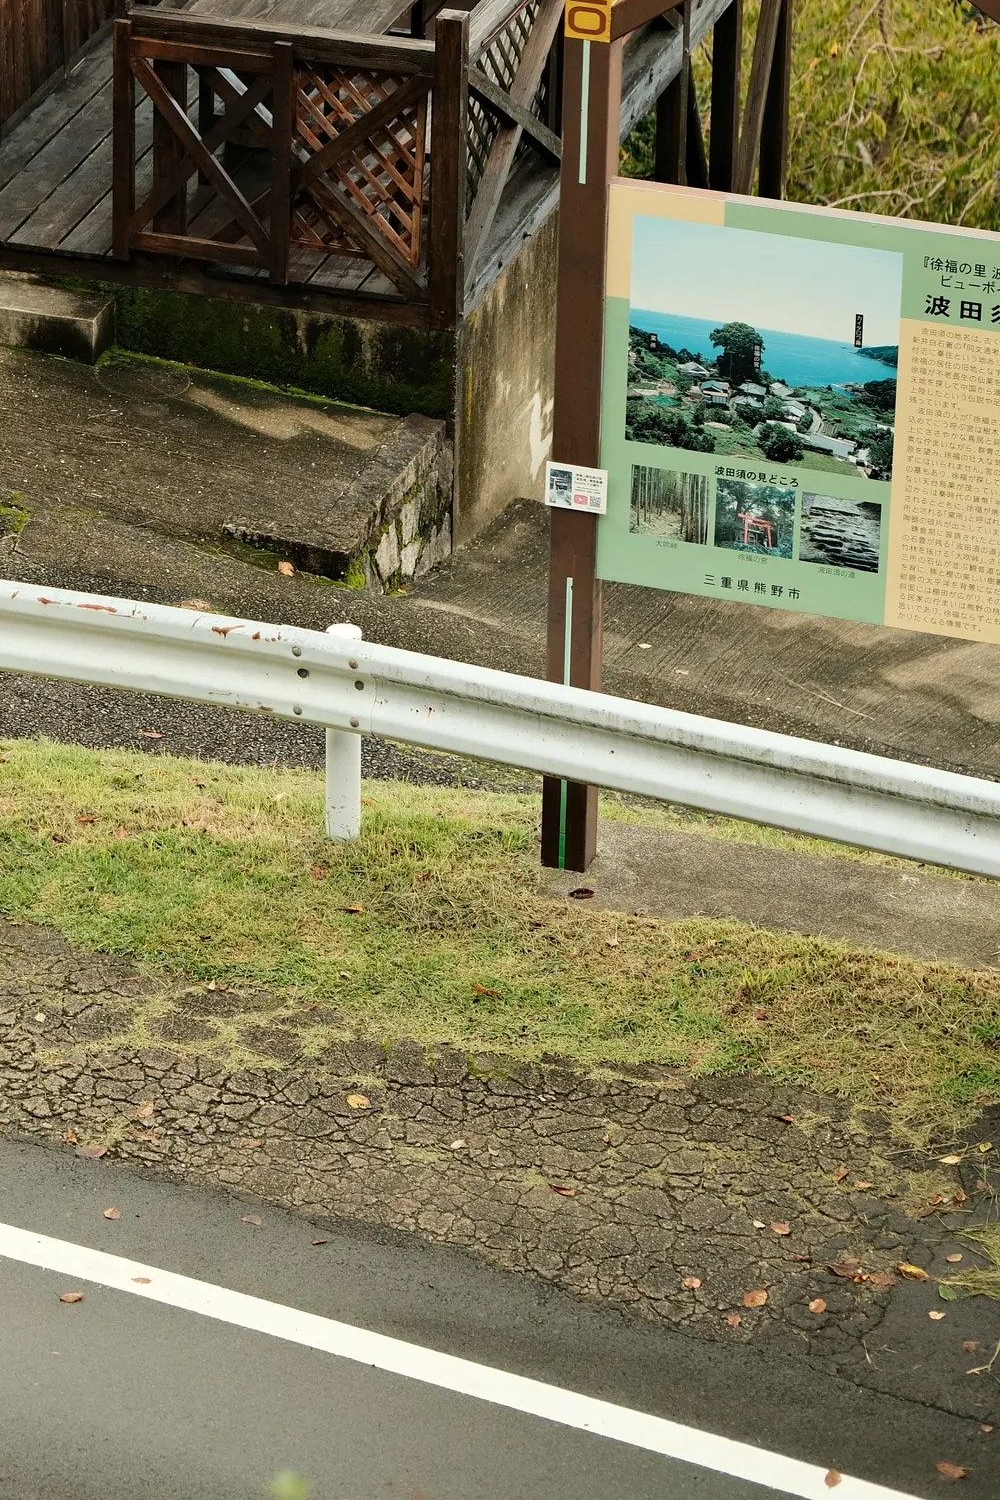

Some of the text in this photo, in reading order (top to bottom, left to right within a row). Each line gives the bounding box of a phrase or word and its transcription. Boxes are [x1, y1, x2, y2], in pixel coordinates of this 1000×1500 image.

[923, 255, 987, 278] 『徐福の里
[941, 274, 1000, 294] ビューポ
[912, 335, 999, 356] 新井白石著の『同文通考
[908, 395, 960, 410] 残っています。
[918, 406, 1000, 426] 波田須の人が「徐福さ
[714, 465, 799, 488] 波田須の見どころ
[901, 533, 999, 555] の石畳が残る「波田須の道
[737, 553, 768, 565] 徐福の宮
[817, 566, 856, 579] 波田須の道
[703, 573, 801, 600] 三重県熊野市
